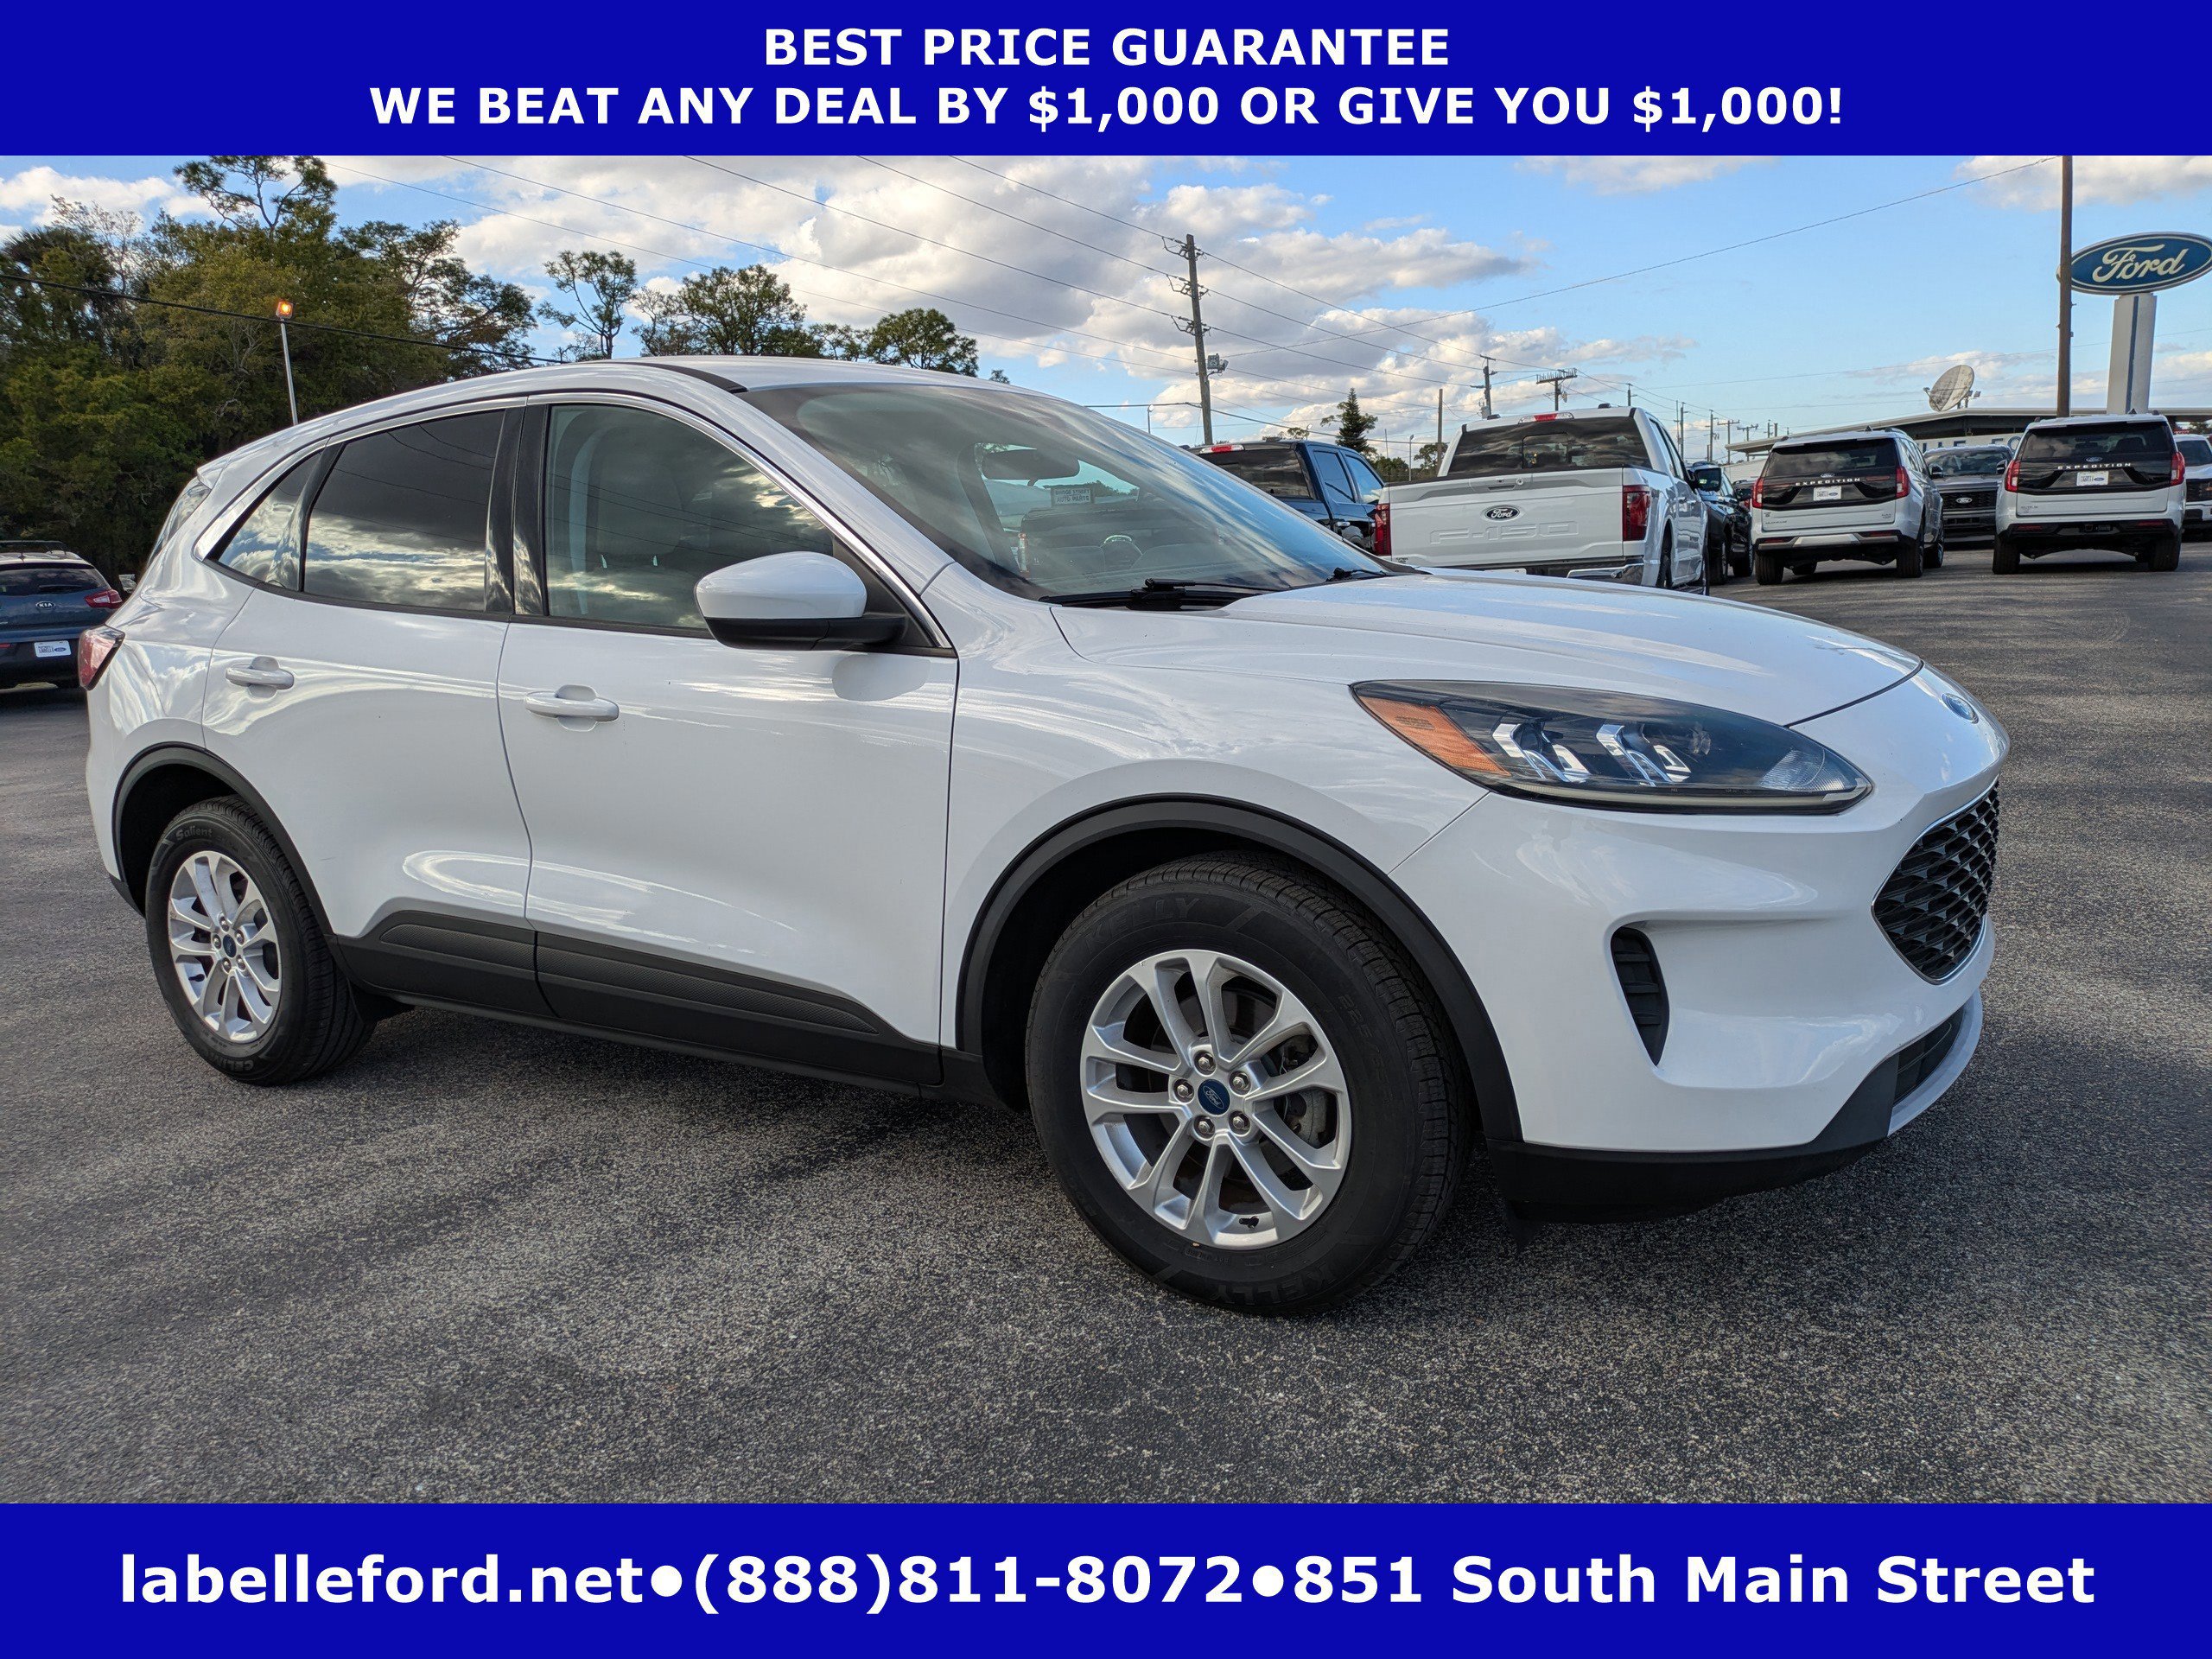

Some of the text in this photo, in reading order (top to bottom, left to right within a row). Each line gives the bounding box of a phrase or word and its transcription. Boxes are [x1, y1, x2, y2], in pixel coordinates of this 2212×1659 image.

[2092, 244, 2189, 283] Ford
[1796, 477, 1860, 486] EXPEDITION
[1491, 508, 1513, 518] Ford
[1430, 521, 1579, 544] F-150
[175, 826, 213, 841] Salient
